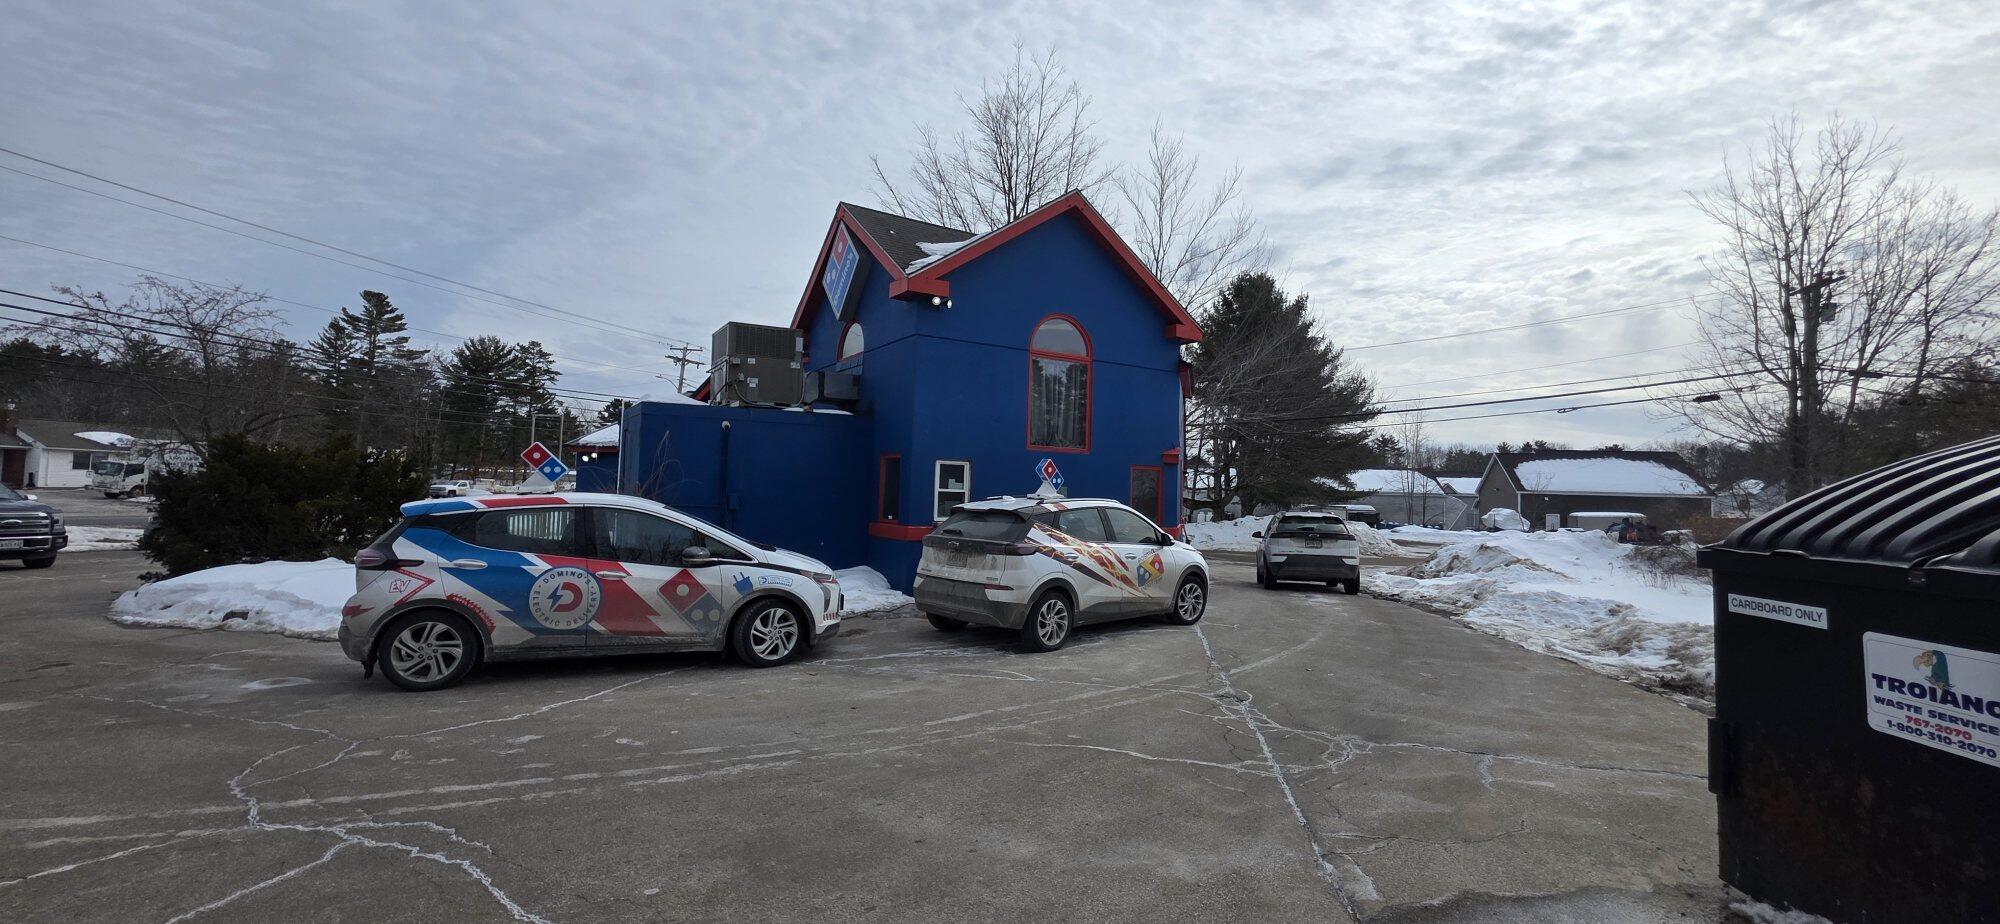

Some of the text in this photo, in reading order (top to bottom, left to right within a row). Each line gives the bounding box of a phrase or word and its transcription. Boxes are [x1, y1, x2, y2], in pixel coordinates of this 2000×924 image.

[543, 570, 592, 585] DOMINO'S
[532, 590, 561, 627] ELECTRIC
[566, 591, 597, 627] DELIVERY
[1731, 597, 1823, 622] CARDBOARD ONLY
[1873, 695, 2000, 736] WASTE SERVICE
[1905, 715, 1972, 741] 767-2070
[1887, 720, 1997, 759] 1-800-310-2070
